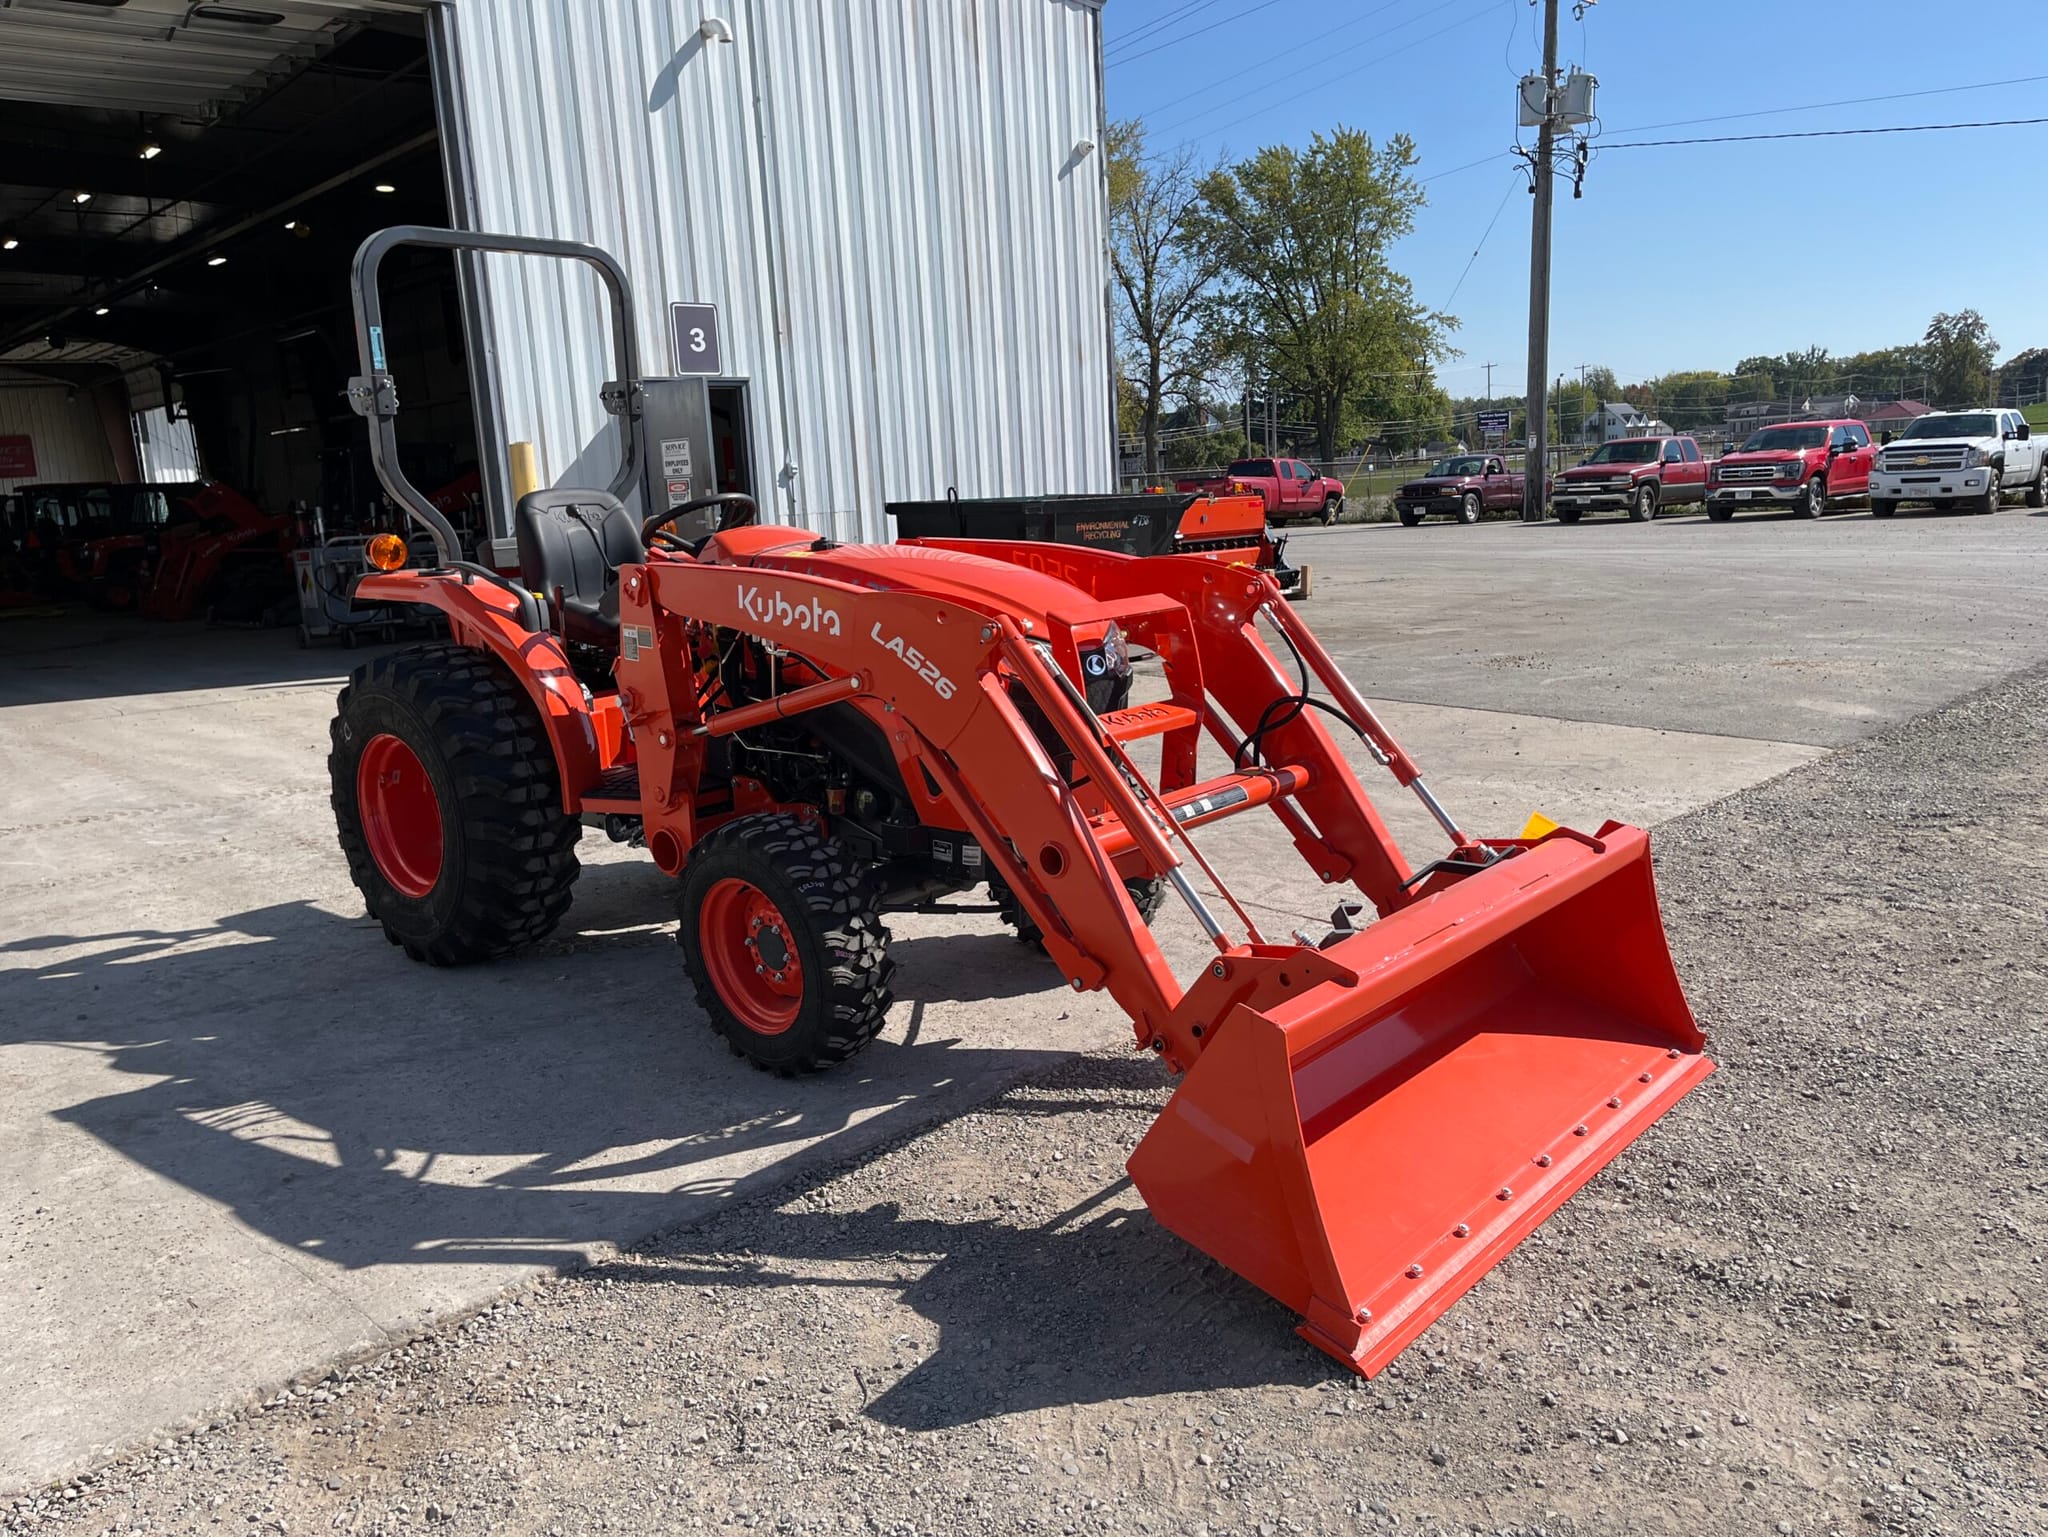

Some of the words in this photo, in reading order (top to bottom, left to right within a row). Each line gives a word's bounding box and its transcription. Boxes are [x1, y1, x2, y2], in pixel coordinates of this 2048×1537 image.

[689, 327, 707, 353] 3
[664, 459, 688, 467] EMPLOYEES
[1076, 520, 1130, 534] ENVIRONMENTAL
[1083, 528, 1121, 541] RECYCLING
[737, 584, 841, 637] Kubota
[869, 621, 957, 701] LA526
[1099, 706, 1169, 726] Kubota
